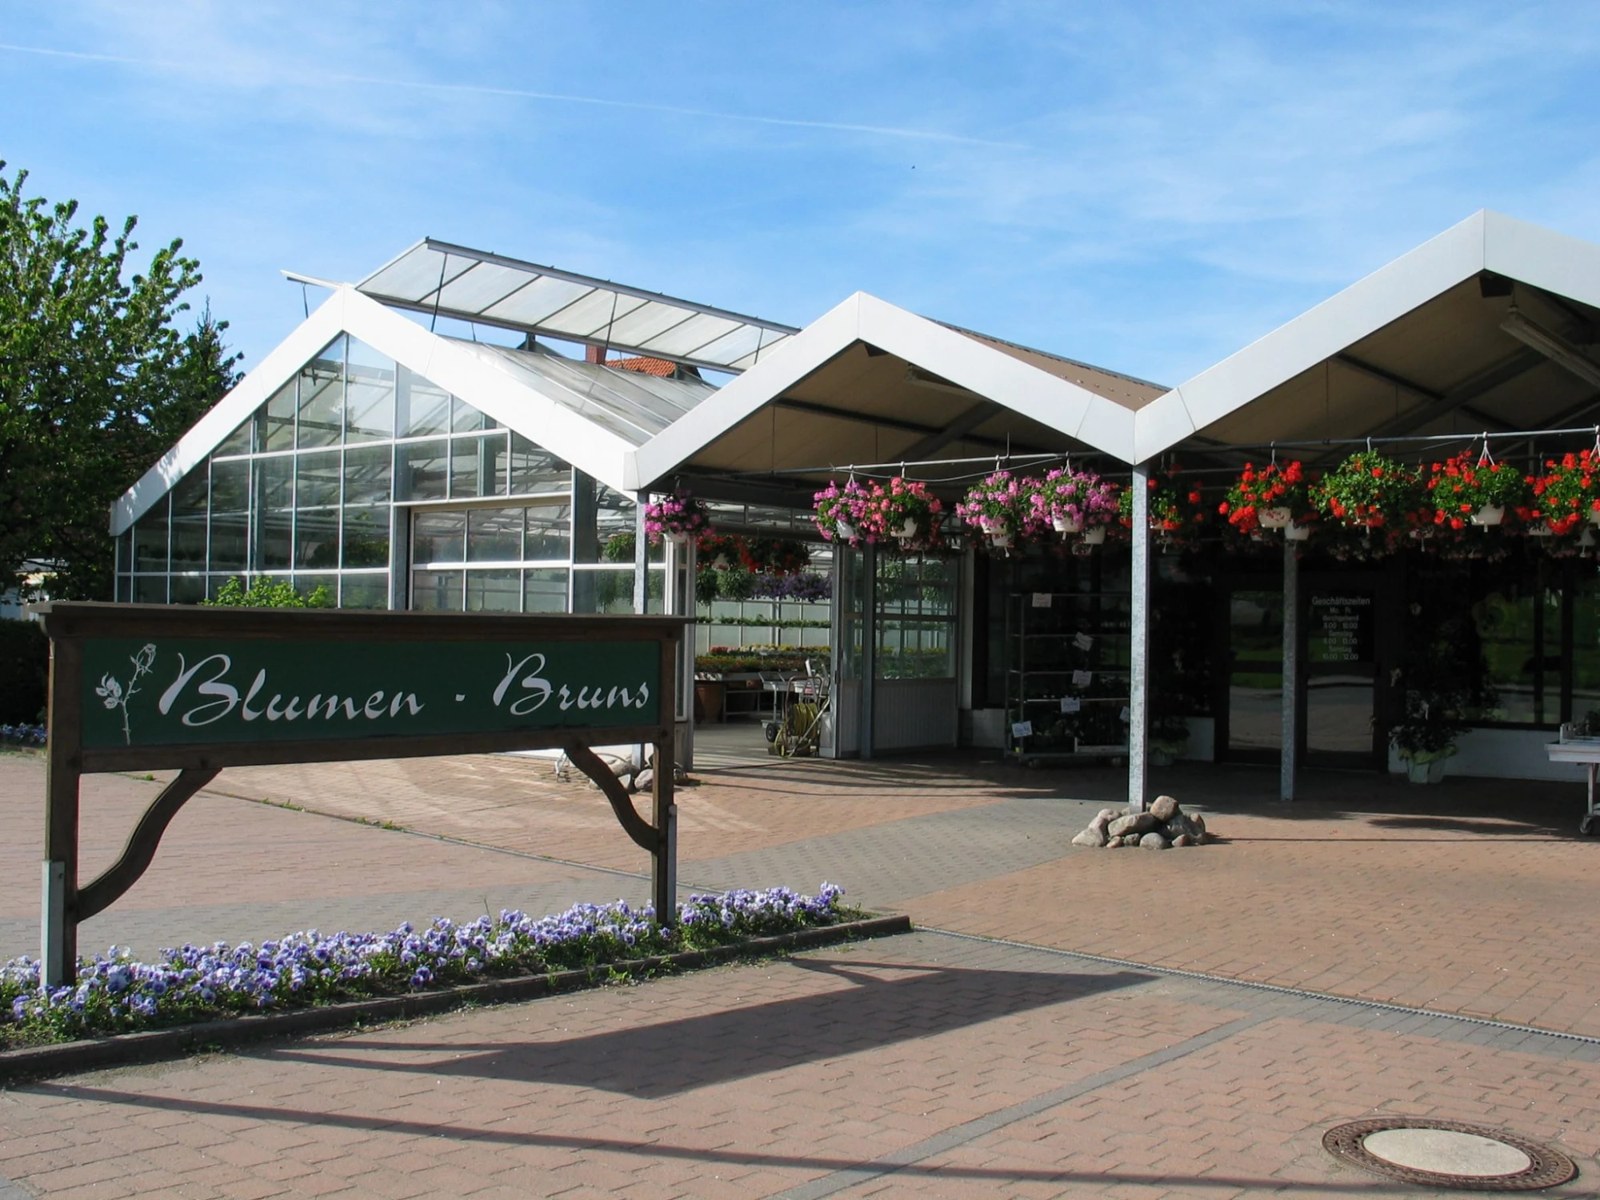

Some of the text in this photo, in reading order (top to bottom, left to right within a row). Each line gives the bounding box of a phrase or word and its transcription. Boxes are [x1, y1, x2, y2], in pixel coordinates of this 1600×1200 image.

[1312, 596, 1370, 605] Geschäftszeiten
[159, 653, 422, 725] Blumen
[493, 653, 648, 715] Bruns
